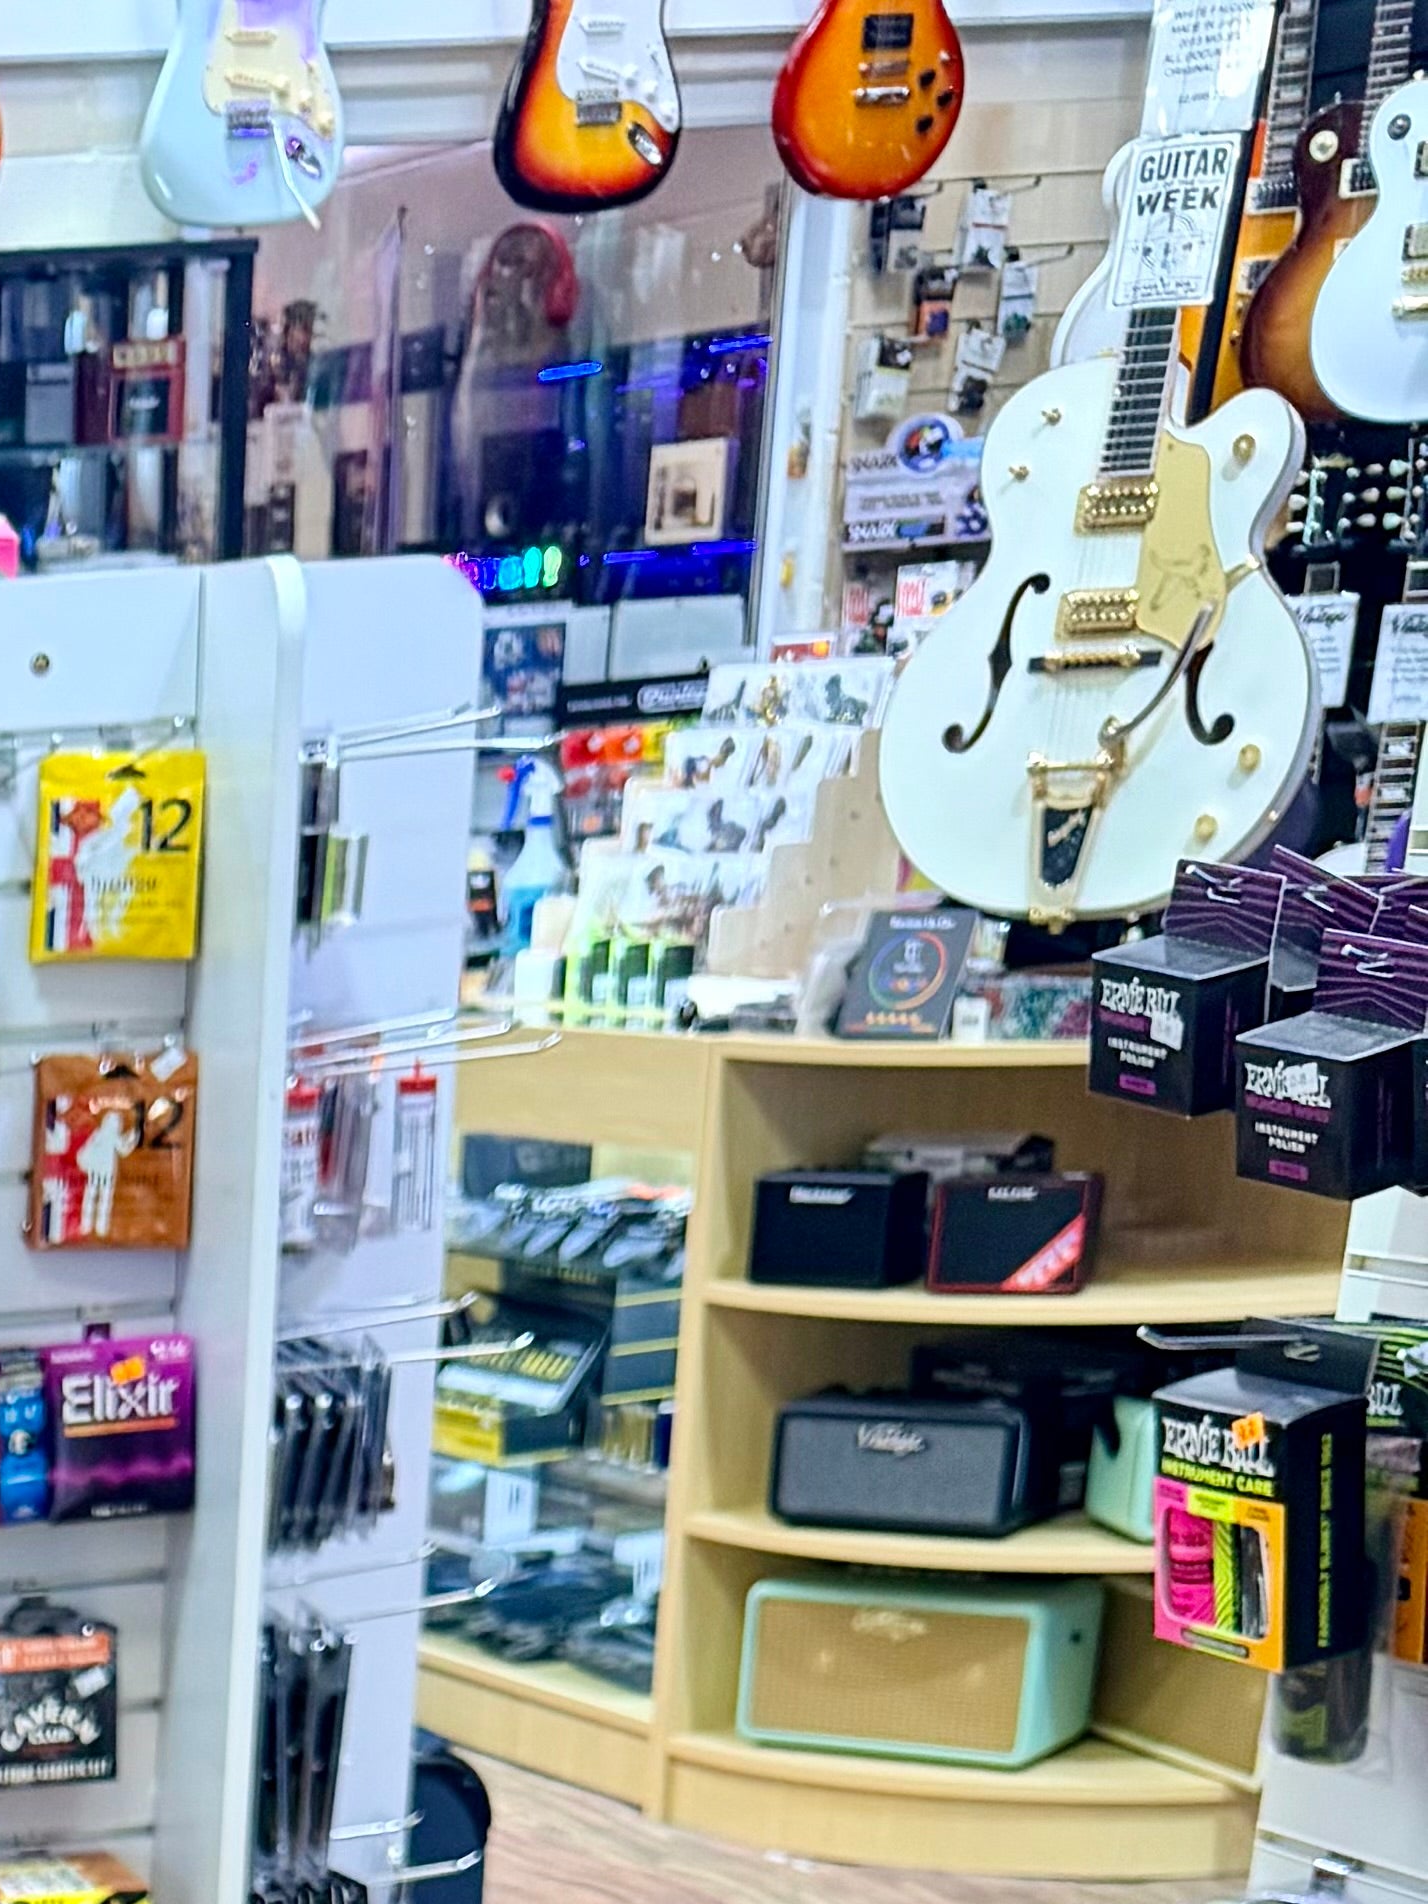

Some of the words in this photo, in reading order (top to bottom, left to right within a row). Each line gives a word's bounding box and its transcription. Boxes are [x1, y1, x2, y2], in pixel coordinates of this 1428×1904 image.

[1140, 147, 1228, 183] GUITAR
[1137, 186, 1220, 216] WEEK
[140, 797, 192, 854] 12
[1101, 976, 1144, 1015] ERNIE
[1108, 1037, 1167, 1060] INSTRUMENT
[1255, 1121, 1318, 1145] INSTRUMENT
[62, 1373, 180, 1425] Elixir
[1161, 1414, 1221, 1466] ERNIE
[1161, 1455, 1235, 1490] INSTRUMENT
[1235, 1475, 1274, 1498] CARE
